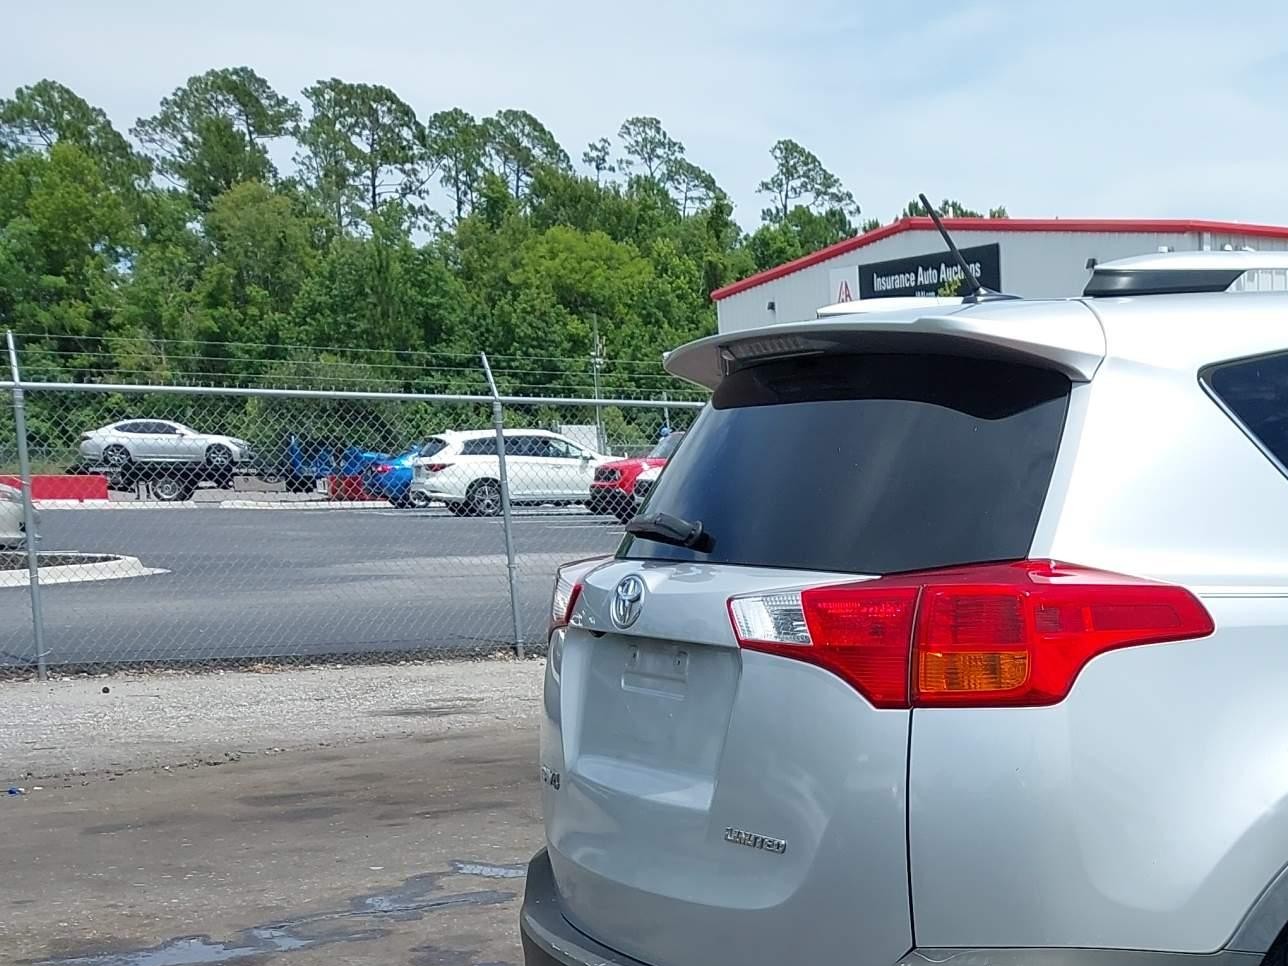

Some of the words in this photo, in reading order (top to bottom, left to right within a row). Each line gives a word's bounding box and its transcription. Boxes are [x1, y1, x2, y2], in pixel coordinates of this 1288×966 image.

[874, 271, 915, 291] Insurance
[917, 266, 938, 285] Auto
[940, 262, 981, 282] Auctins
